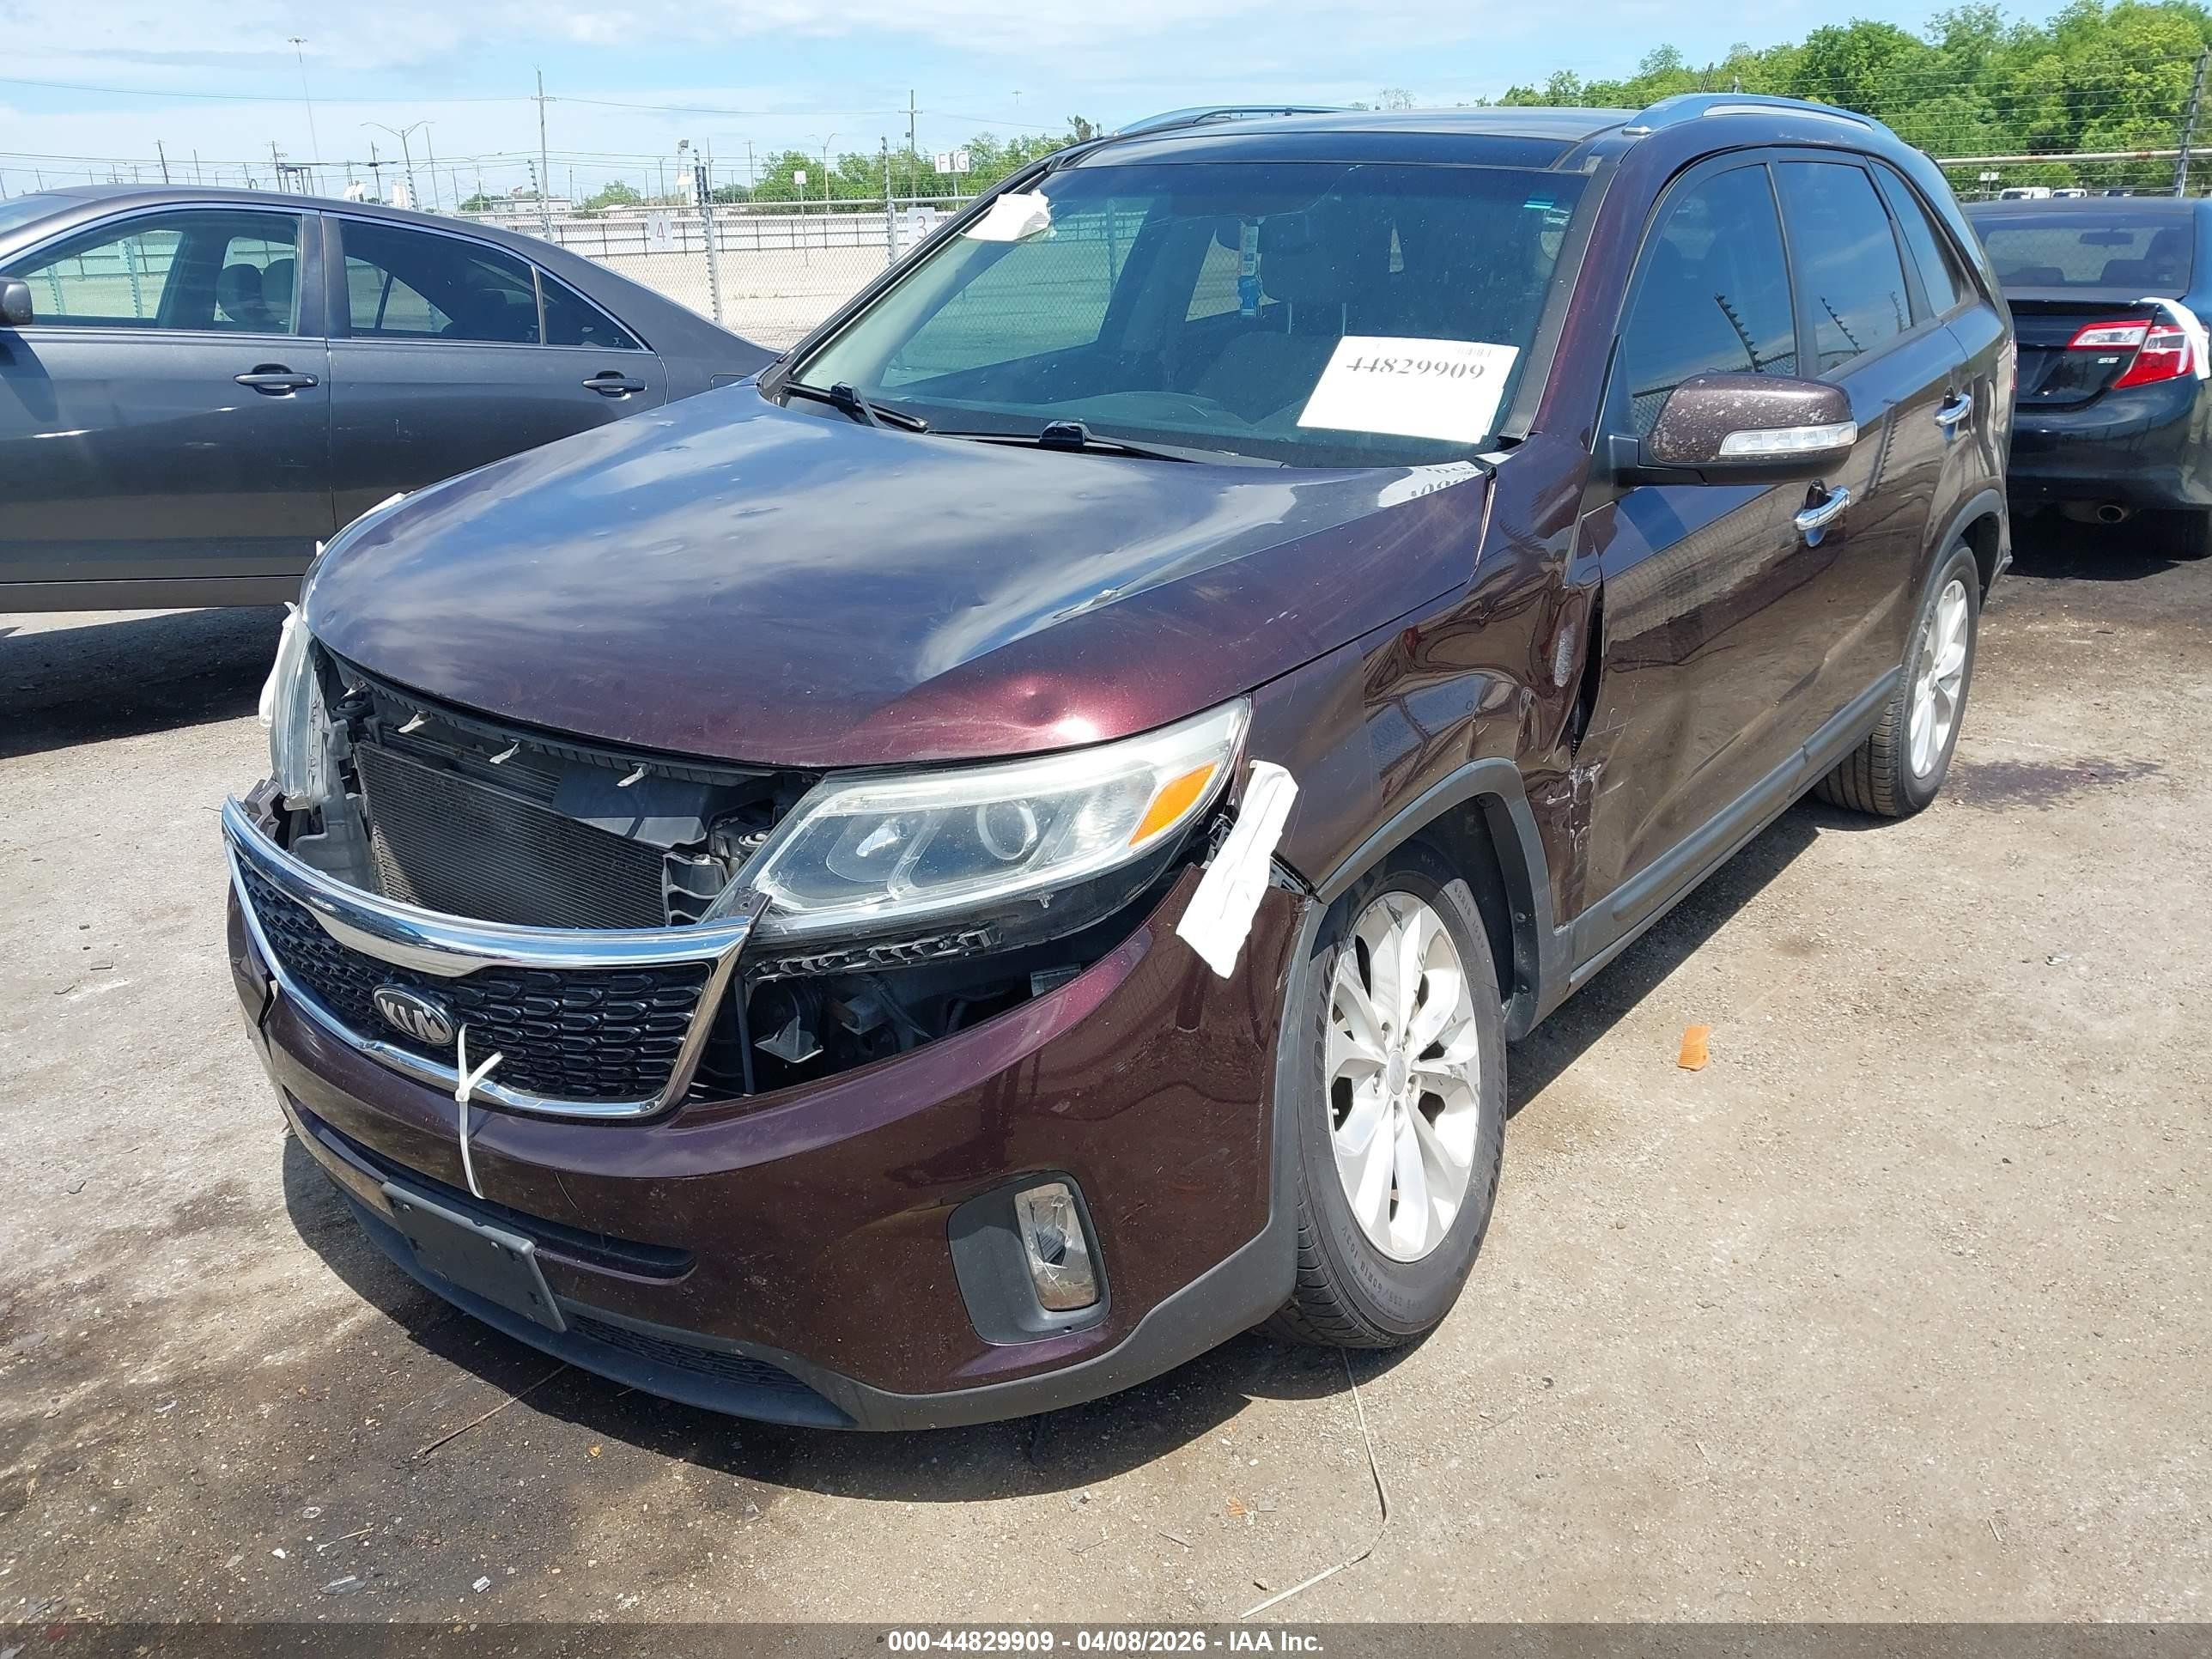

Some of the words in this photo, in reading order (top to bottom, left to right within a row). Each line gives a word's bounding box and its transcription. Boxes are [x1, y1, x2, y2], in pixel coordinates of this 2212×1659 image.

[938, 153, 946, 172] F
[956, 152, 968, 171] G
[656, 222, 666, 243] 4
[916, 215, 927, 240] 3
[1346, 356, 1486, 380] 44829909
[378, 995, 448, 1043] KIA
